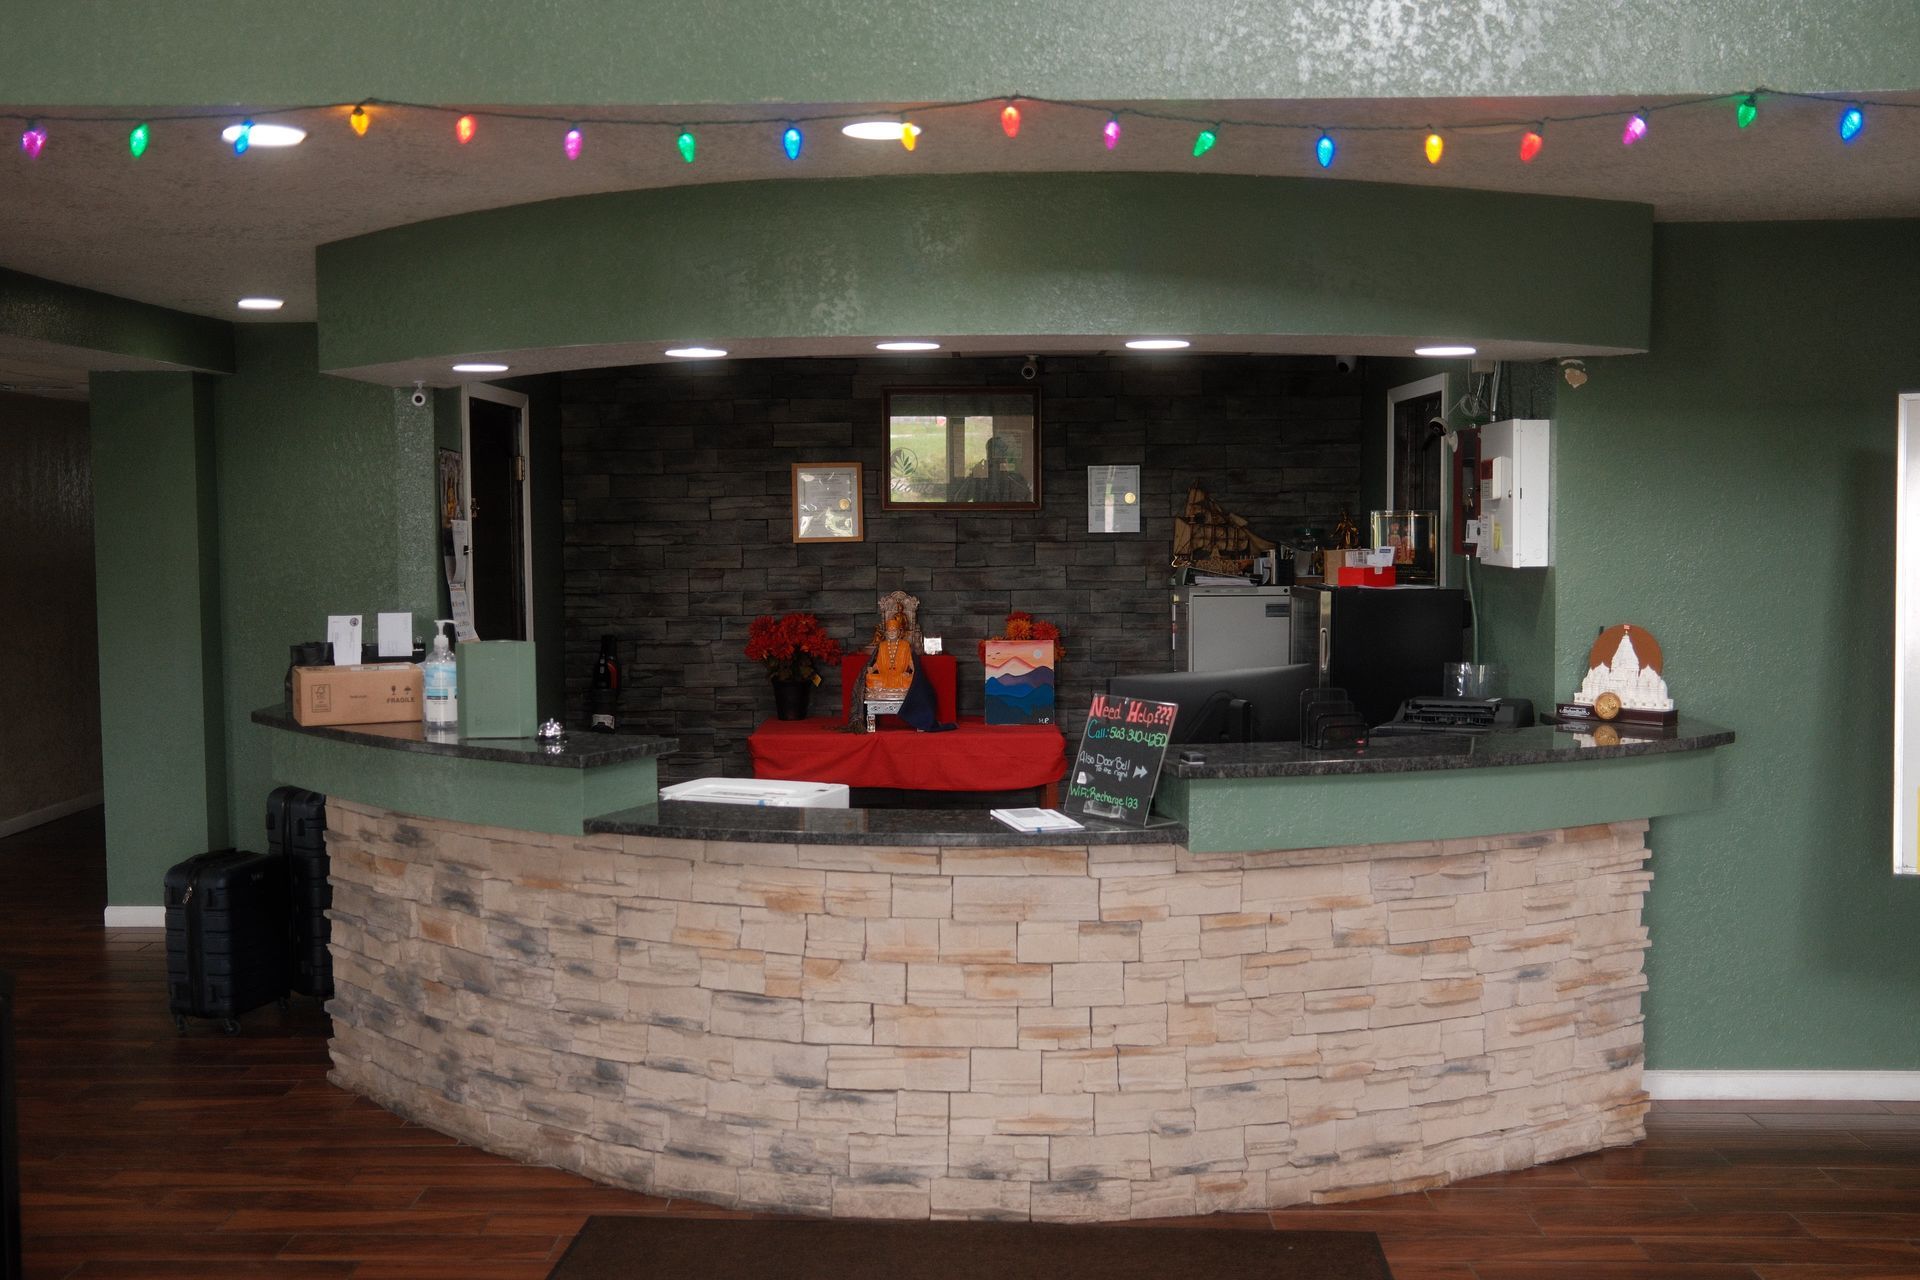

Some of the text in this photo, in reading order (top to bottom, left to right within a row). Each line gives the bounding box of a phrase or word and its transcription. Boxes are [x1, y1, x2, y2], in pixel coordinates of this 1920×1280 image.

[386, 696, 416, 705] FRAGILE
[1090, 696, 1173, 728] Need Help???
[1080, 750, 1095, 764] Also
